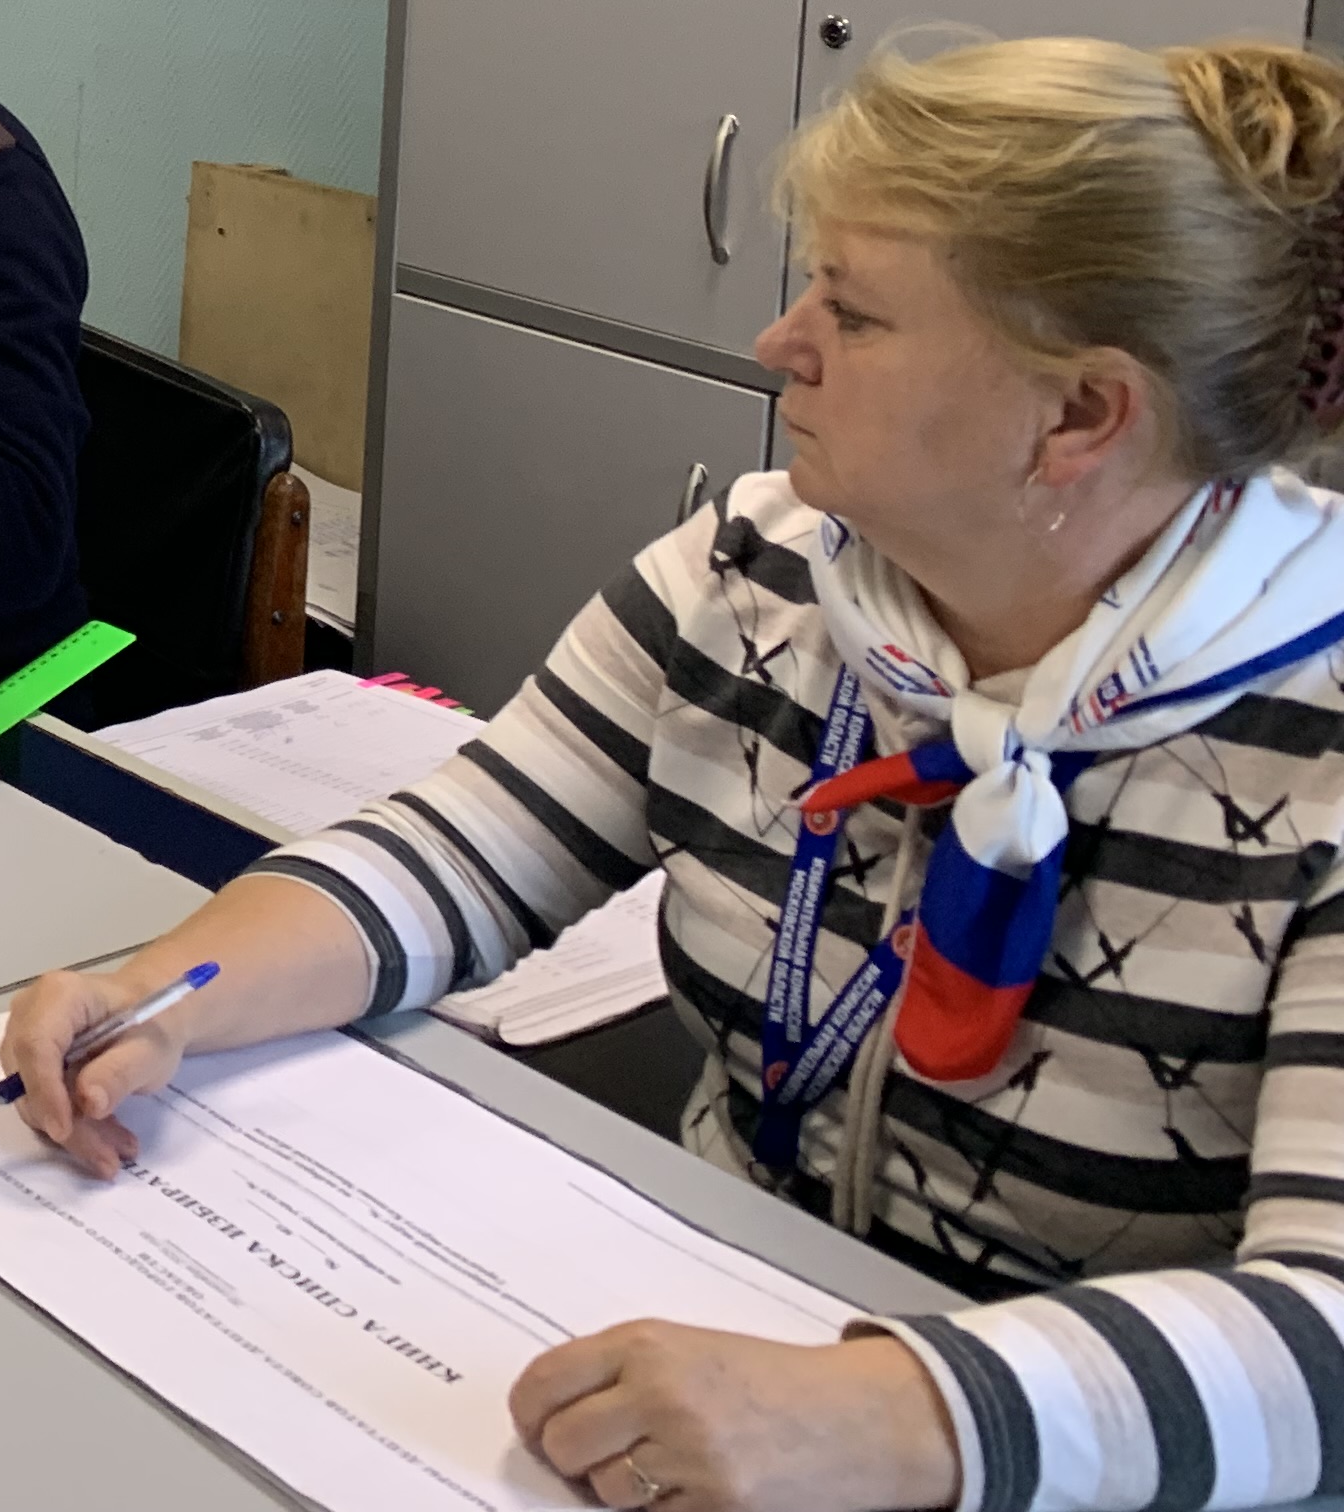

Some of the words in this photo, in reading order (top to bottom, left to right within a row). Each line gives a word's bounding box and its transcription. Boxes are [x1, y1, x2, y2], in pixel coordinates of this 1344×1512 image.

[819, 706, 848, 765] ОБЛАСТИ
[778, 869, 807, 959] МОСКОВСКОЙ
[791, 856, 826, 967] ИЗБИРАТЕЛЬНАЯ
[768, 961, 789, 1023] ОБЛАСТИ
[840, 987, 886, 1044] ОБЛАСТИ
[246, 1239, 359, 1320] СПИСКА
[360, 1317, 464, 1385] КНИГА
